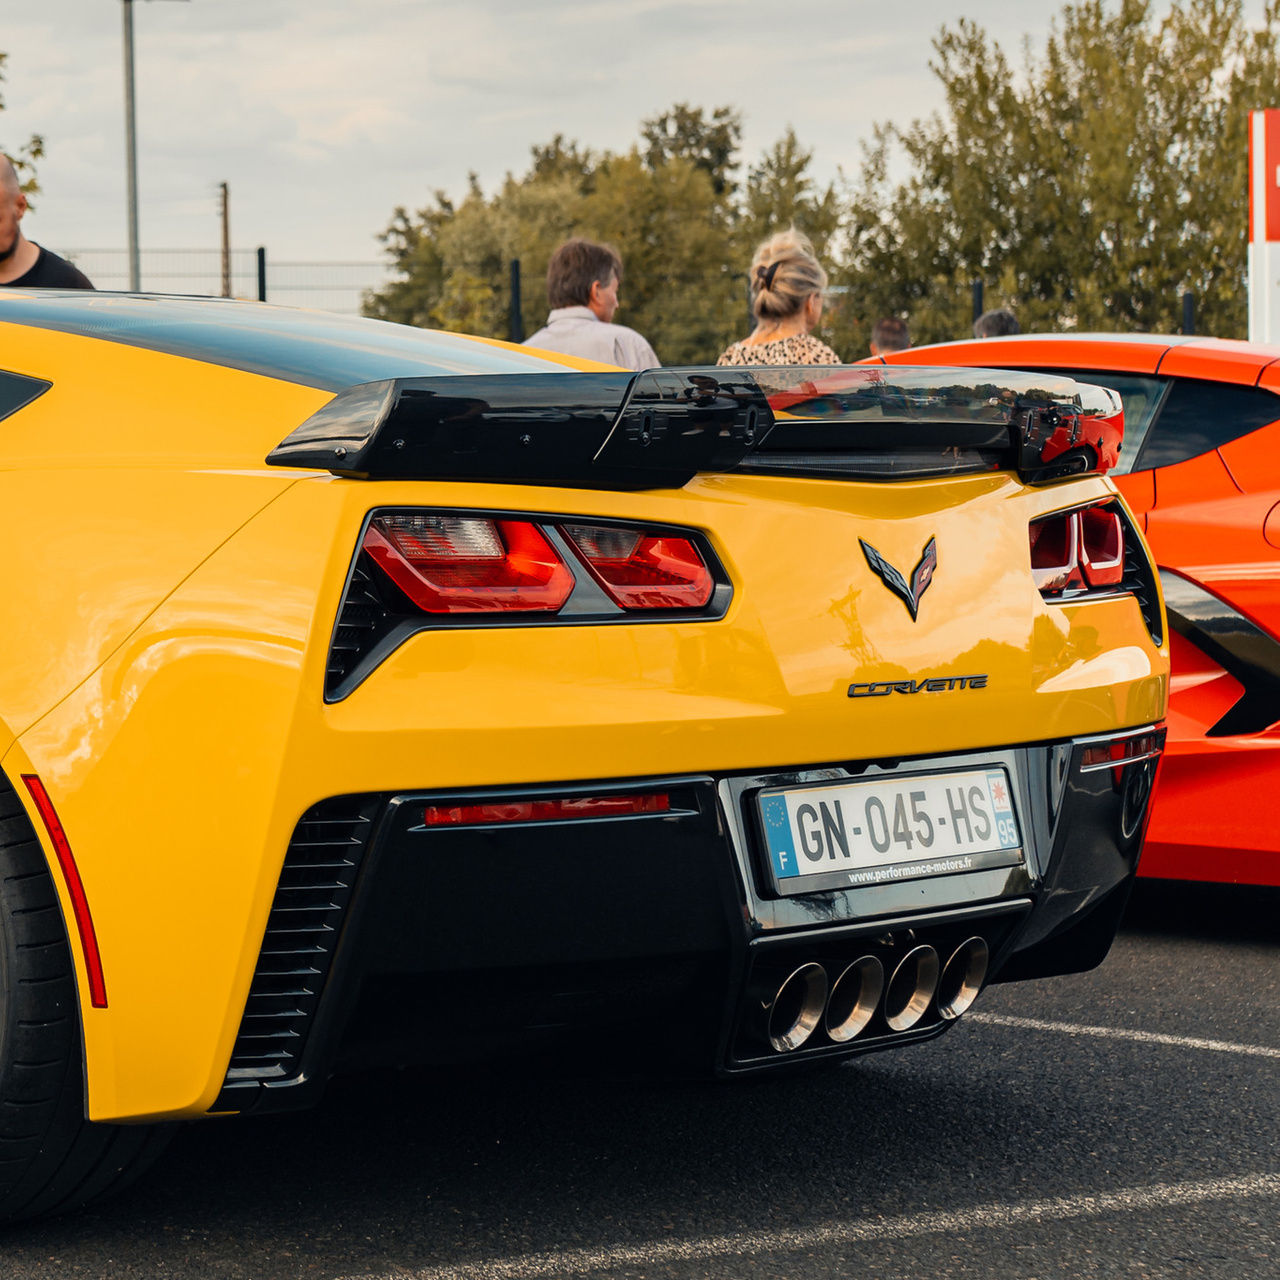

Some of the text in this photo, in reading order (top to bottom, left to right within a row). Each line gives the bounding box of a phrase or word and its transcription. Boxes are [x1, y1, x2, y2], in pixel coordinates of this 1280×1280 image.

[847, 674, 988, 697] CORVETTE
[796, 786, 991, 861] GN-045-HS
[998, 818, 1018, 845] 95
[778, 851, 788, 871] F
[849, 857, 972, 883] www.performance-motors.fr
